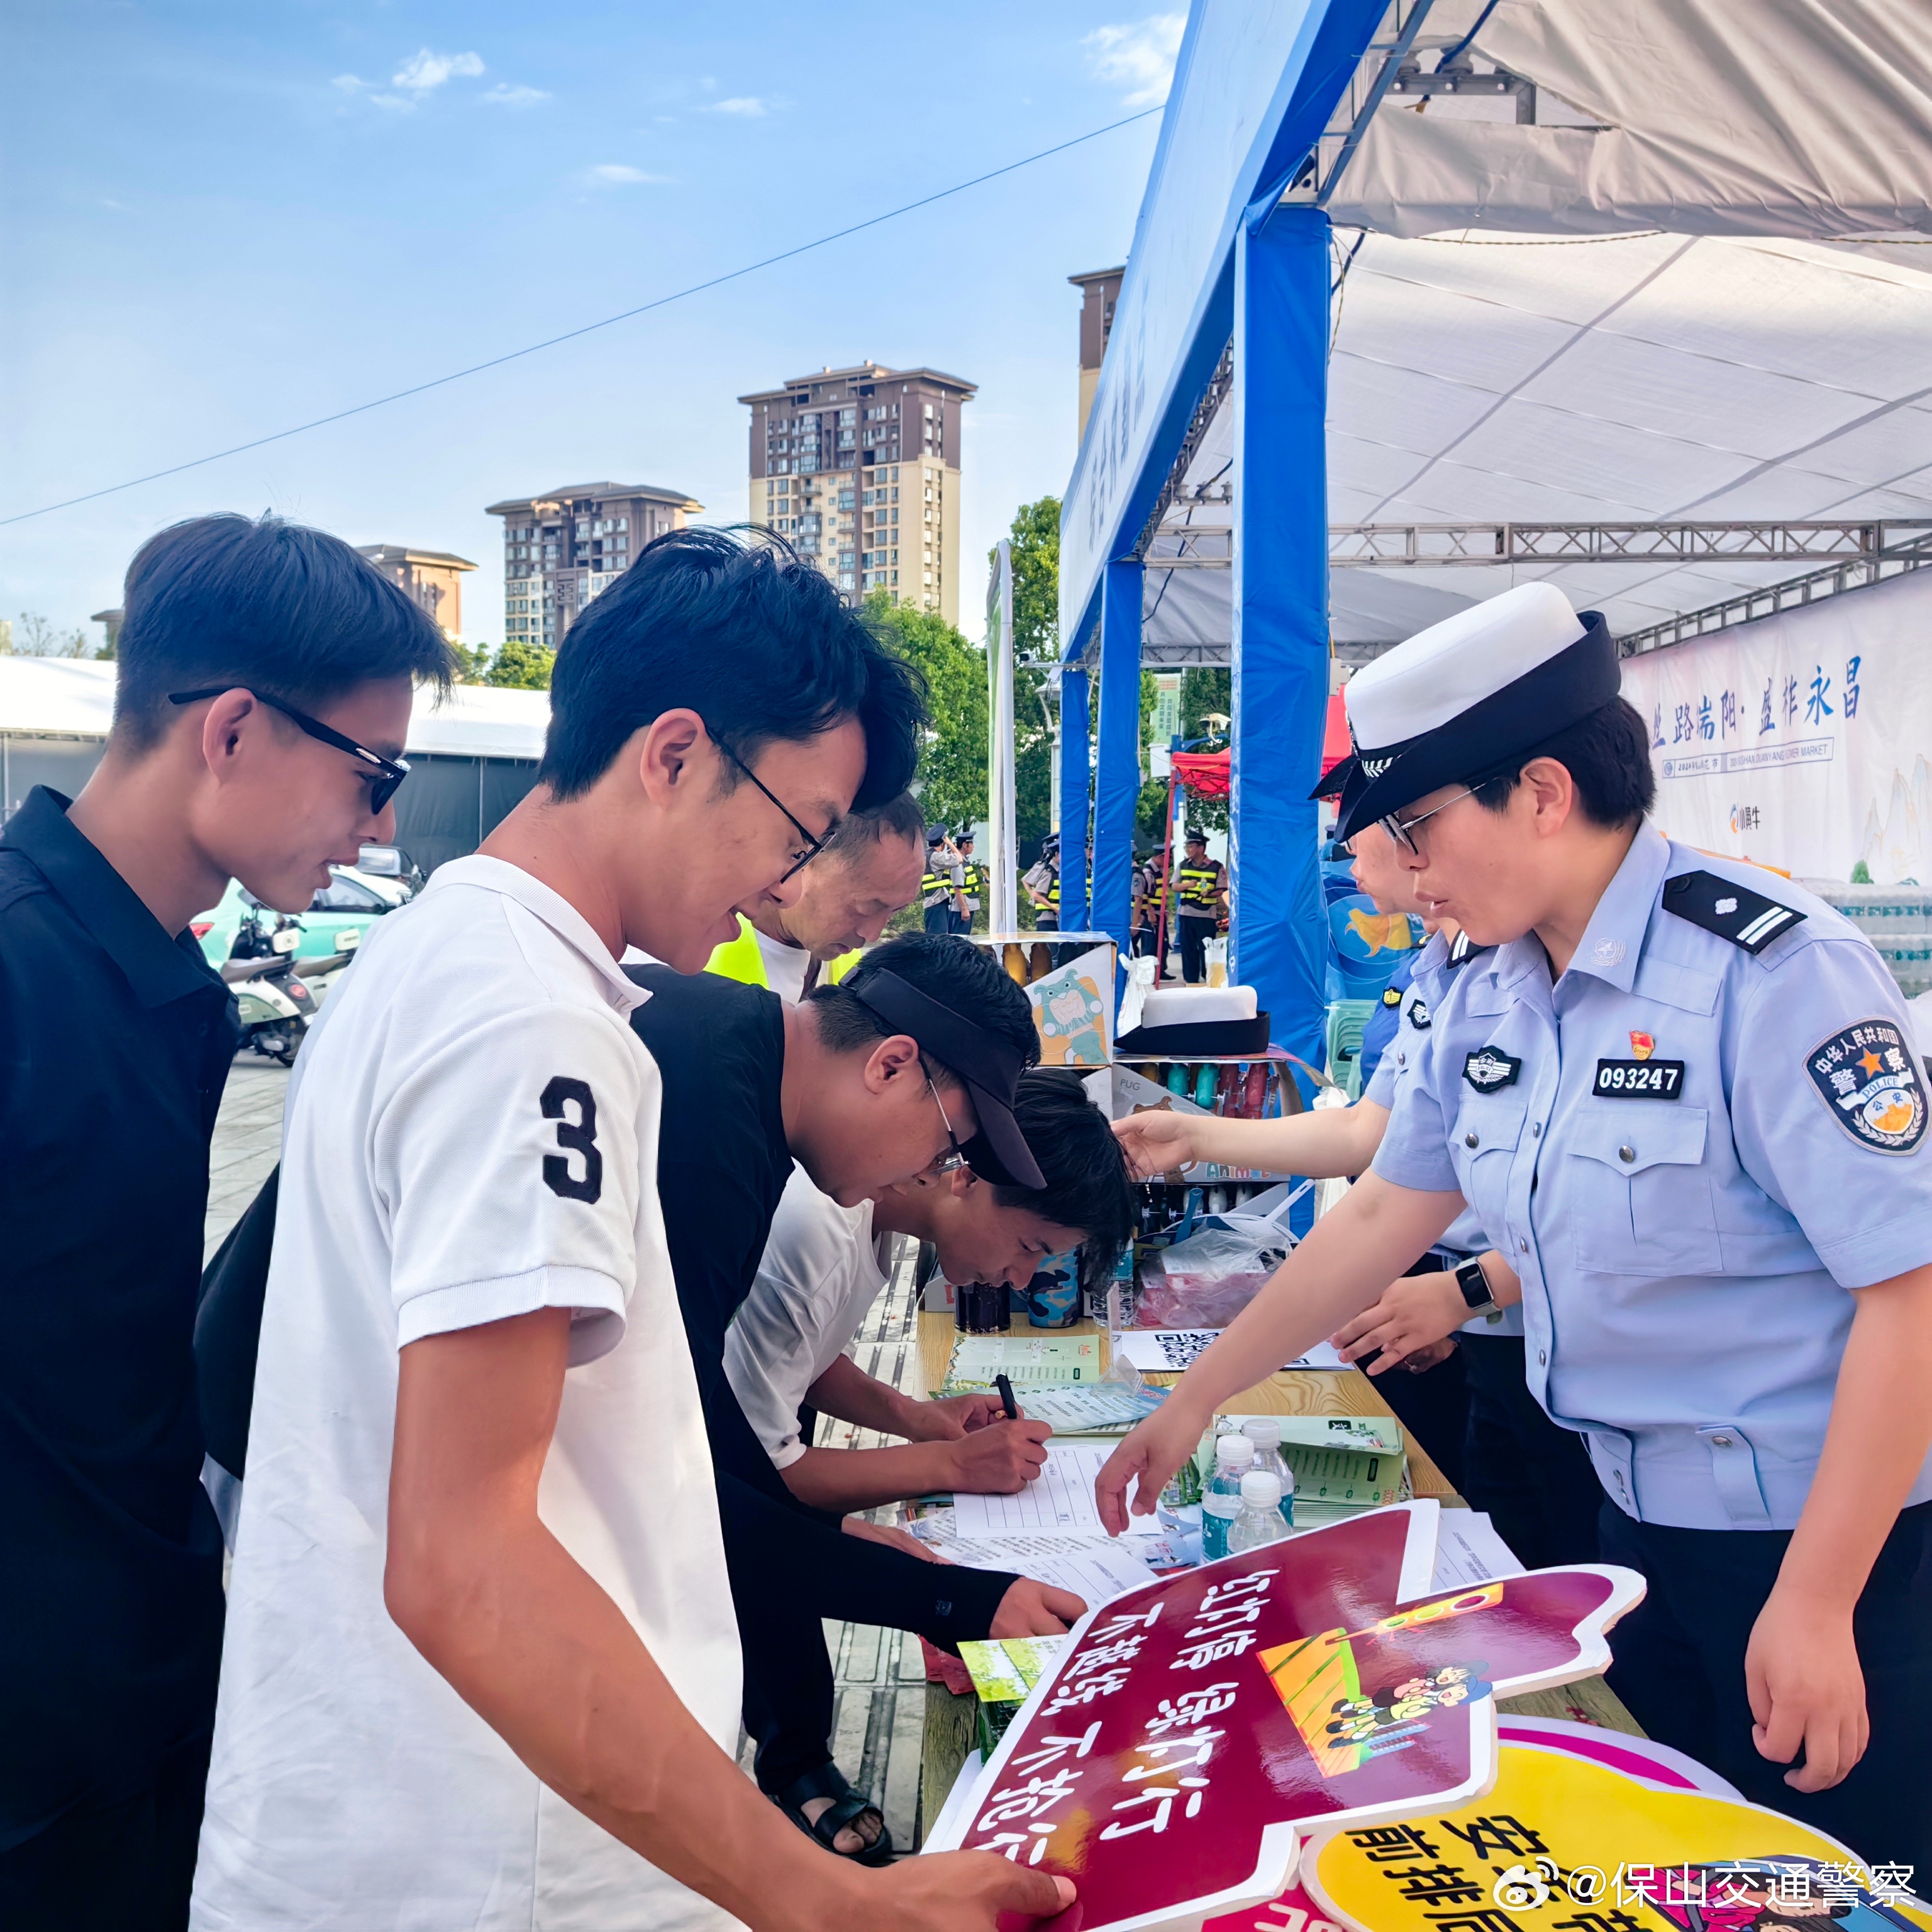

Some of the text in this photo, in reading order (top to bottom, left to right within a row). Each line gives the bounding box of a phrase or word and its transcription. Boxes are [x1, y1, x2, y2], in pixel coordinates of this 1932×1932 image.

[1801, 744, 1828, 757] MARKET
[1739, 806, 1760, 830] 小黄牛
[1815, 1026, 1899, 1074] 中华人民共和国
[1120, 1079, 1141, 1091] PUG
[1599, 1067, 1678, 1091] 093247
[1862, 1077, 1899, 1099] POLICE
[1872, 1092, 1903, 1112] 公安
[540, 1076, 602, 1205] 3
[1040, 1601, 1165, 1716] 不越线
[1099, 1569, 1280, 1840] 红灯停 绿灯行
